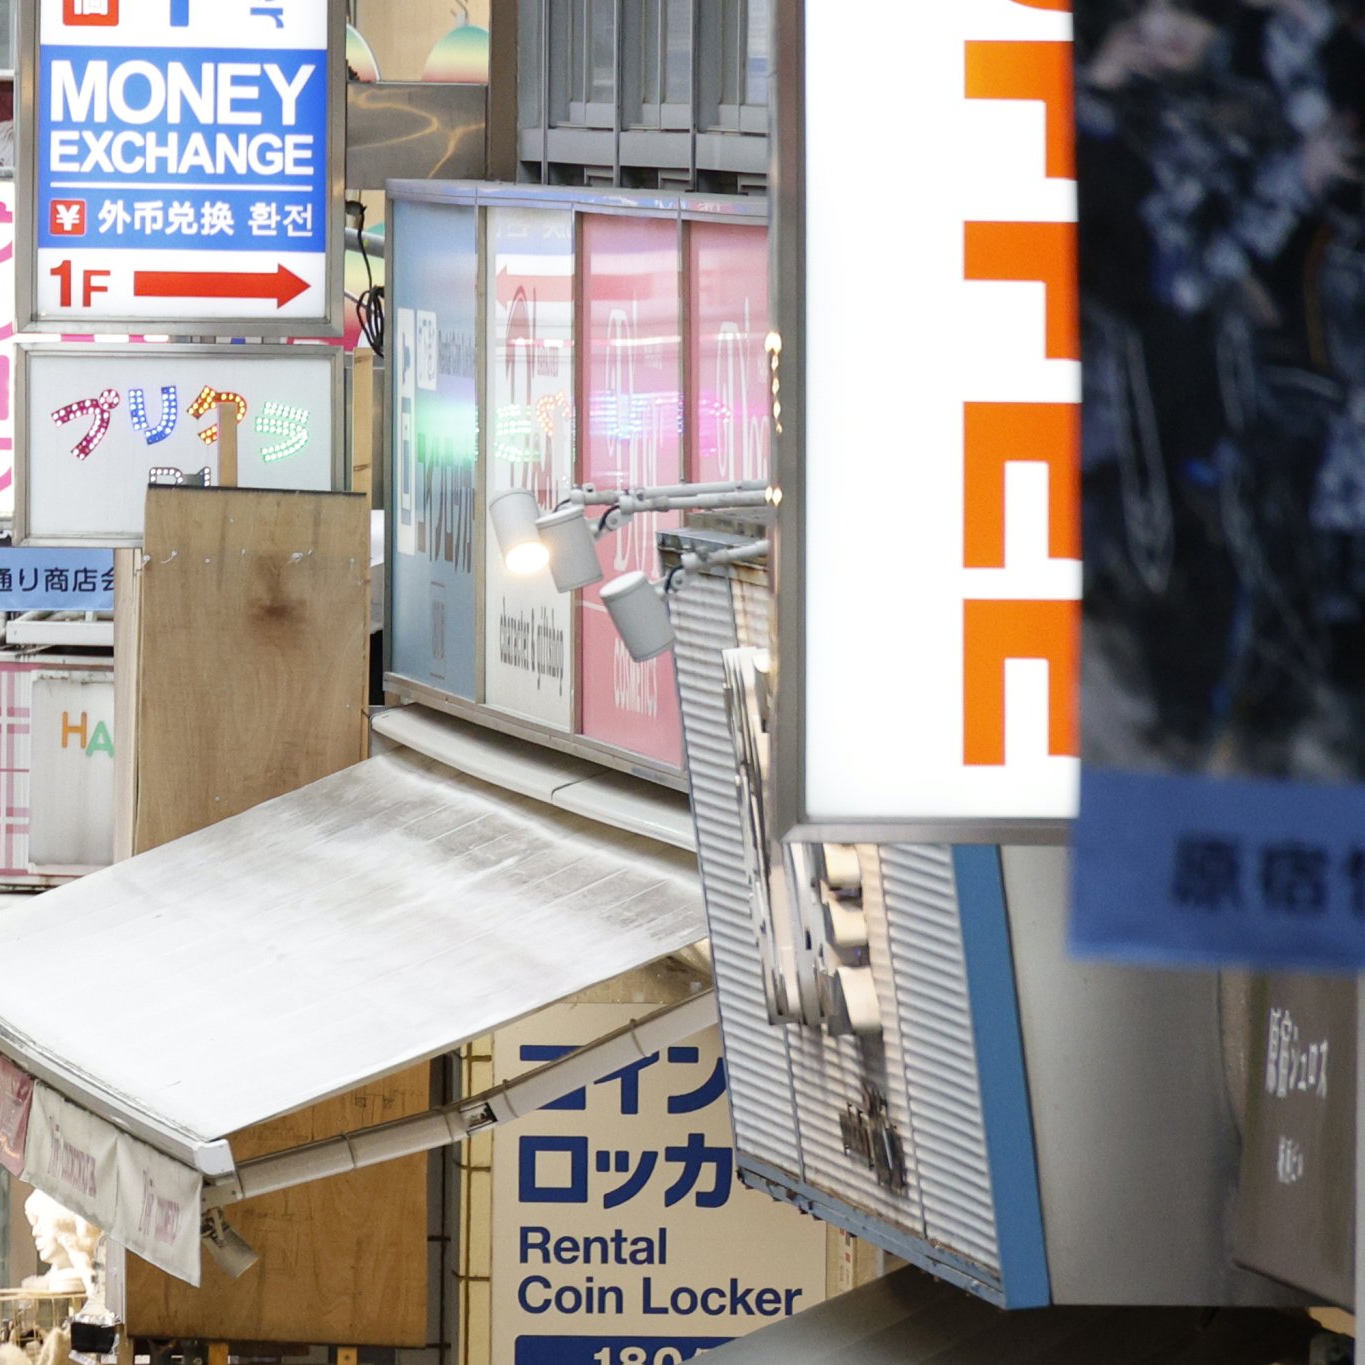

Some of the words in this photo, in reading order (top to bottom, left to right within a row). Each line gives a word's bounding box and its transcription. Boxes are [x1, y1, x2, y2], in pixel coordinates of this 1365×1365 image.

[50, 61, 316, 126] MONEY
[50, 131, 314, 176] EXCHANGE
[97, 201, 234, 237] 外币兑换
[248, 202, 314, 237] 환전
[50, 260, 111, 308] 1F
[50, 385, 309, 463] プリクラ
[518, 1133, 733, 1209] ロッカ
[519, 1225, 668, 1266] Rental
[517, 1274, 625, 1316] Coin
[642, 1277, 804, 1317] Locker
